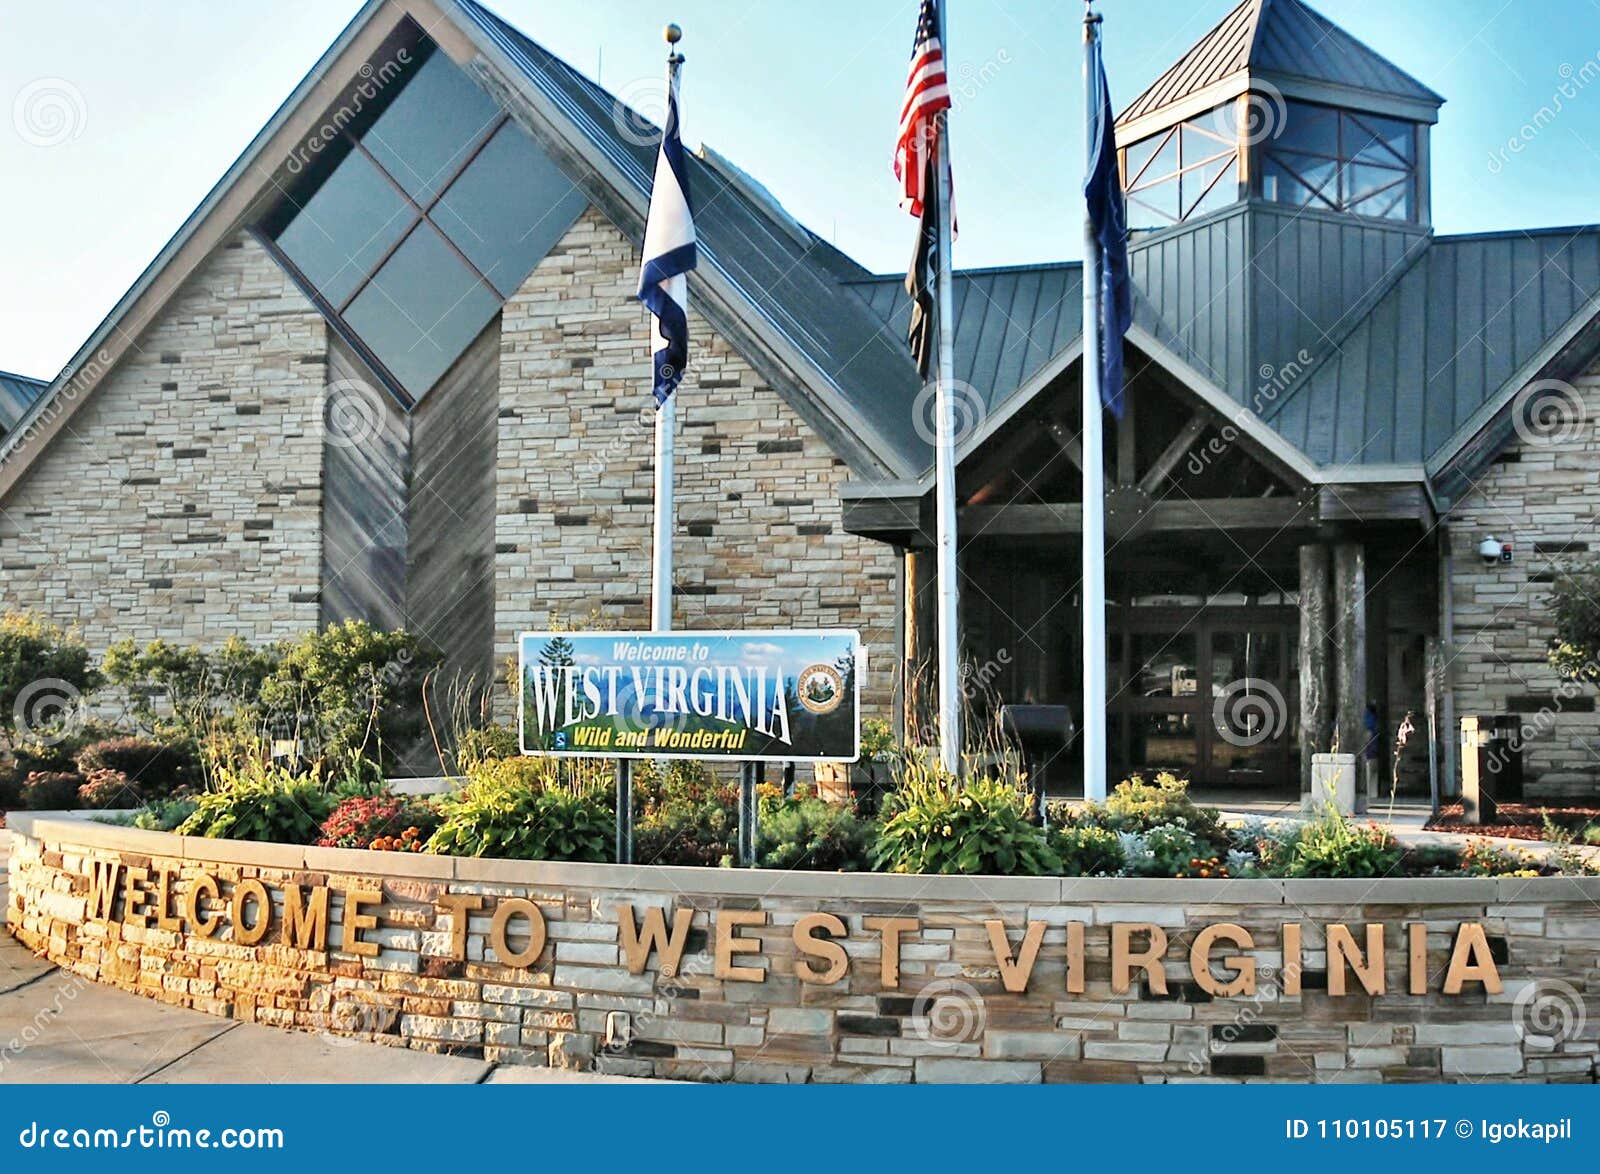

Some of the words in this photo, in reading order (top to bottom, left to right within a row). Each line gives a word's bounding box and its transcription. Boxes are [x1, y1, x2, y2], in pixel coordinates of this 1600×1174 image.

[613, 642, 686, 661] Welcome
[689, 643, 709, 661] to
[531, 665, 622, 736] WEST
[631, 665, 793, 746] VIRGINIA
[573, 726, 610, 748] Wild
[615, 727, 649, 748] and
[653, 728, 747, 750] Wonderful
[87, 860, 385, 957] WELCOME
[437, 894, 548, 968] TO
[616, 904, 921, 988] WEST
[984, 919, 1504, 998] VIRGINIA
